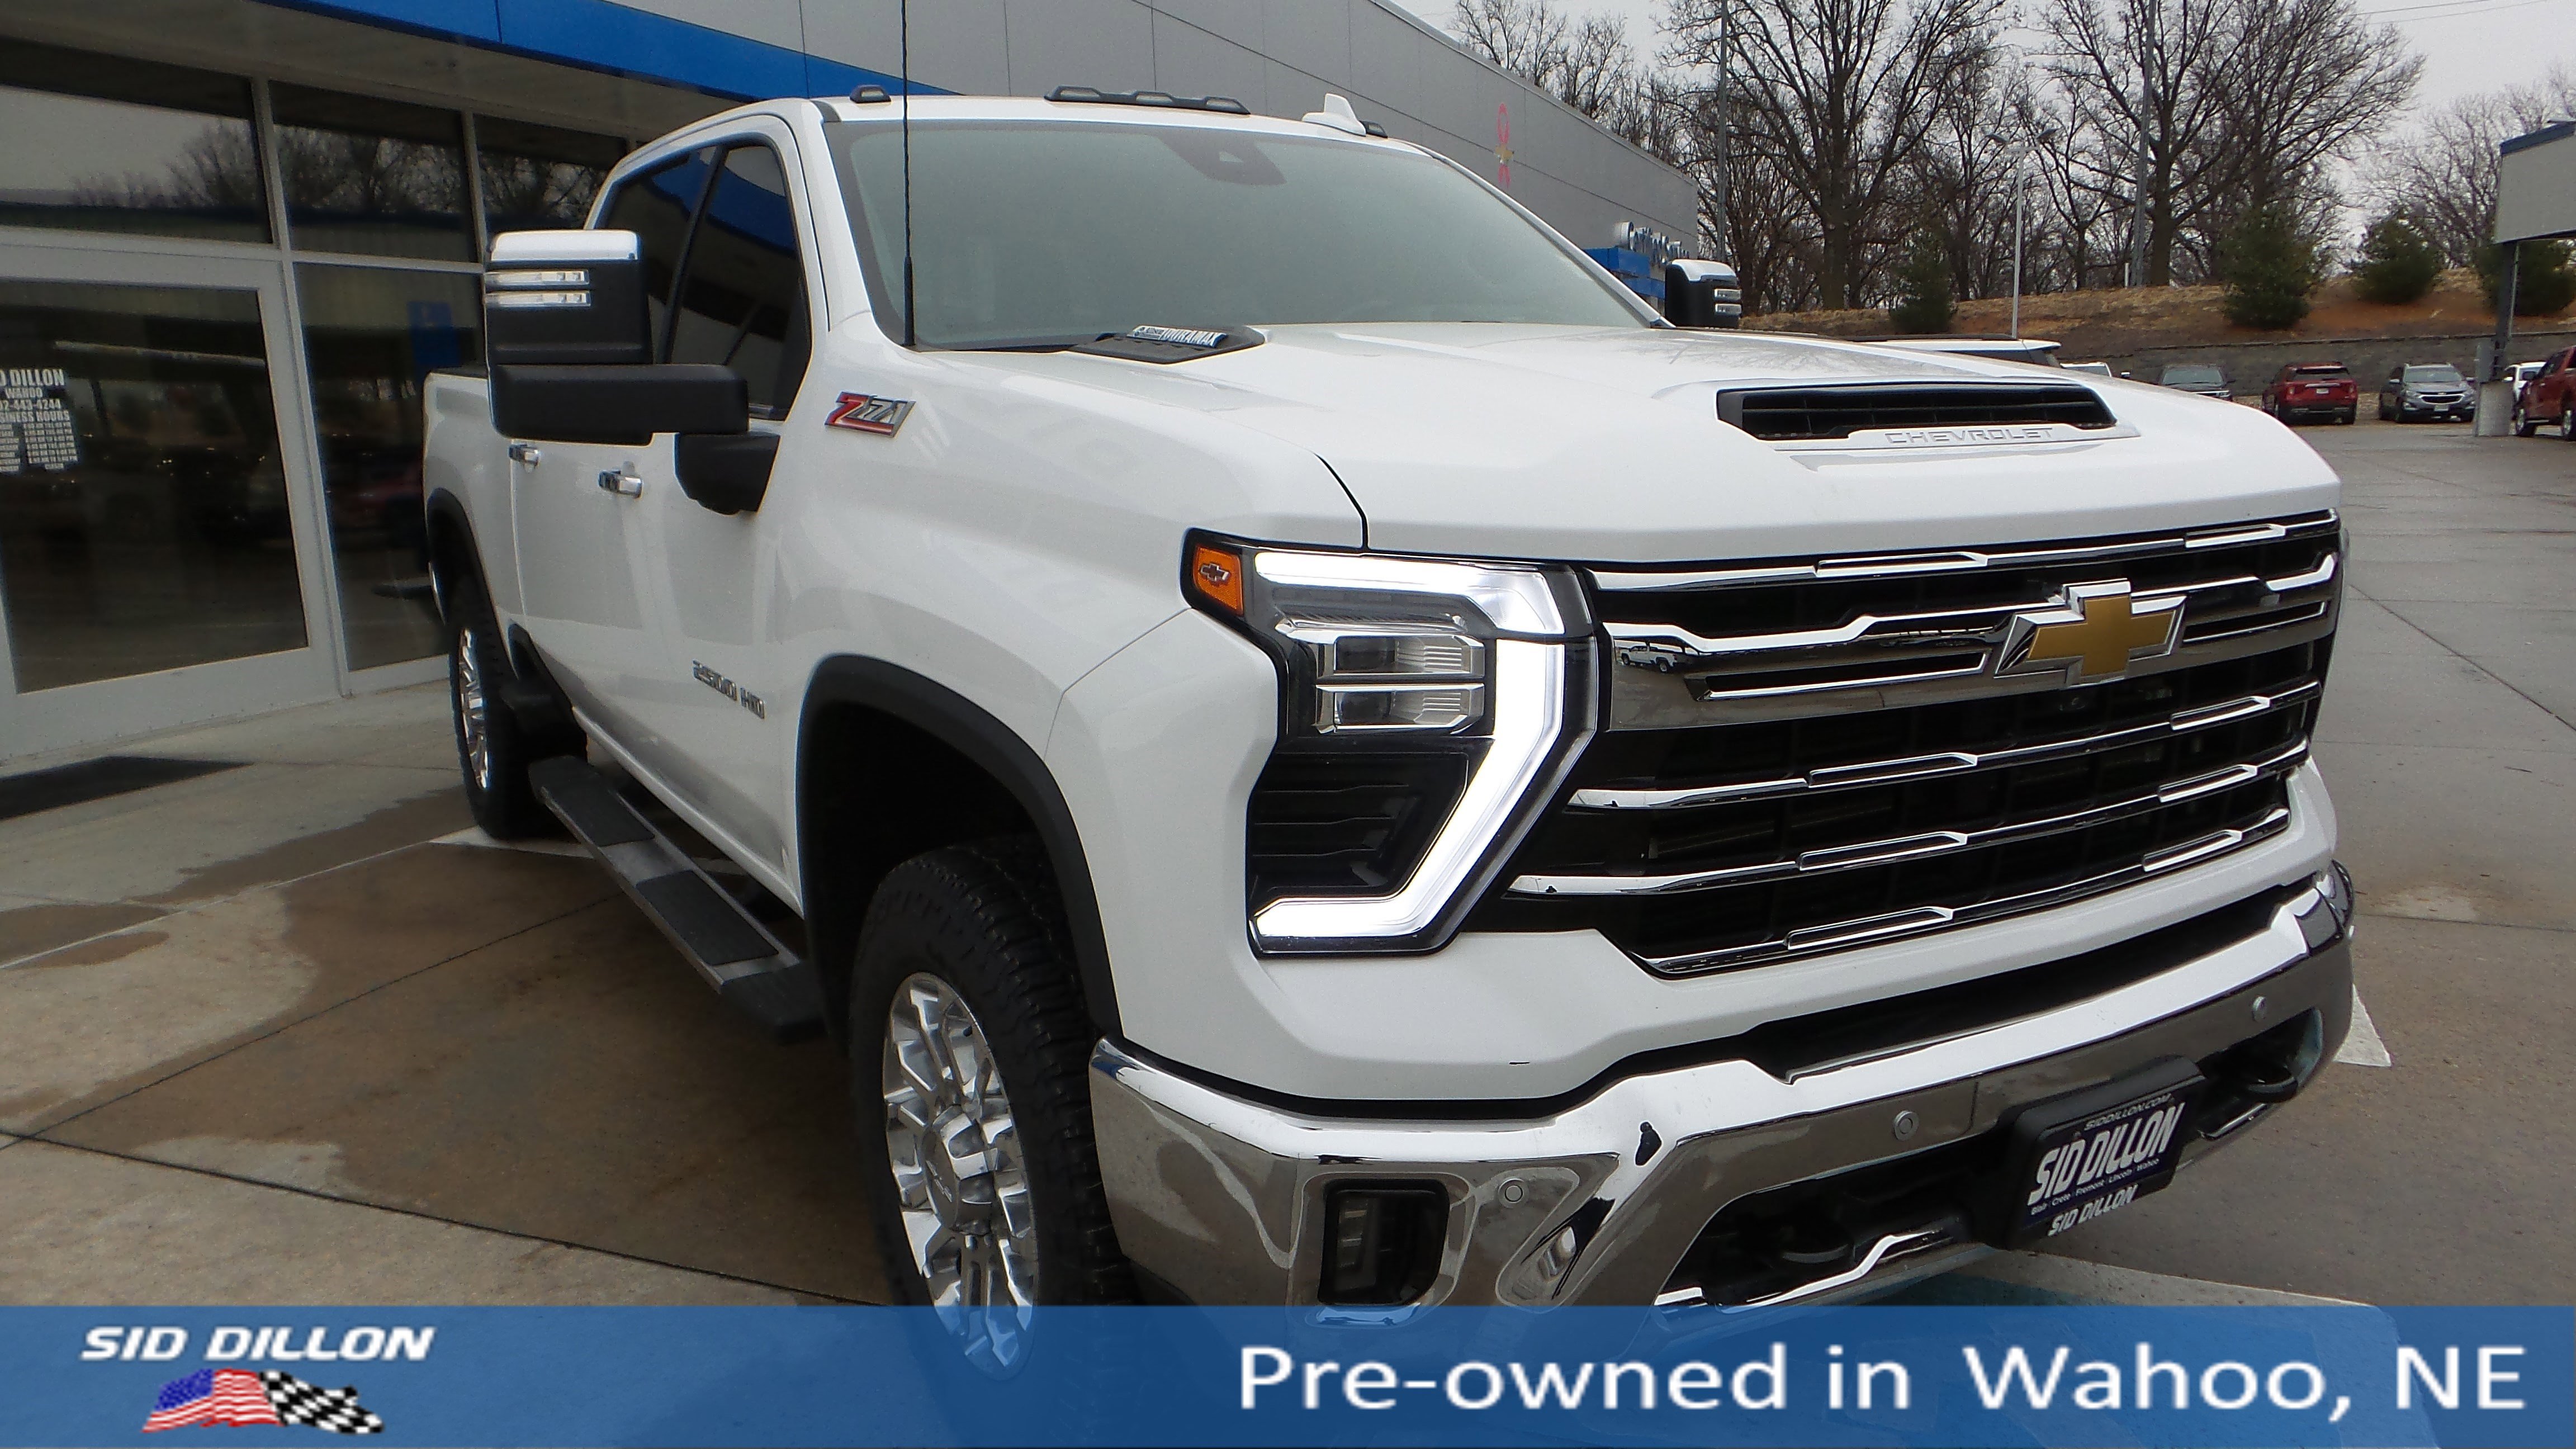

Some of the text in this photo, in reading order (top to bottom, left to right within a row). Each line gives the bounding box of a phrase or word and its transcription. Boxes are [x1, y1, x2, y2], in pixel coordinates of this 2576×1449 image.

[10, 368, 65, 386] DILLON
[5, 387, 43, 399] WAHOO
[36, 409, 70, 422] HOURS
[825, 391, 916, 438] Z71
[1884, 427, 2053, 444] CHEVROLET
[2027, 1102, 2186, 1206] SID DILLON
[2047, 1183, 2139, 1236] SID DILLON
